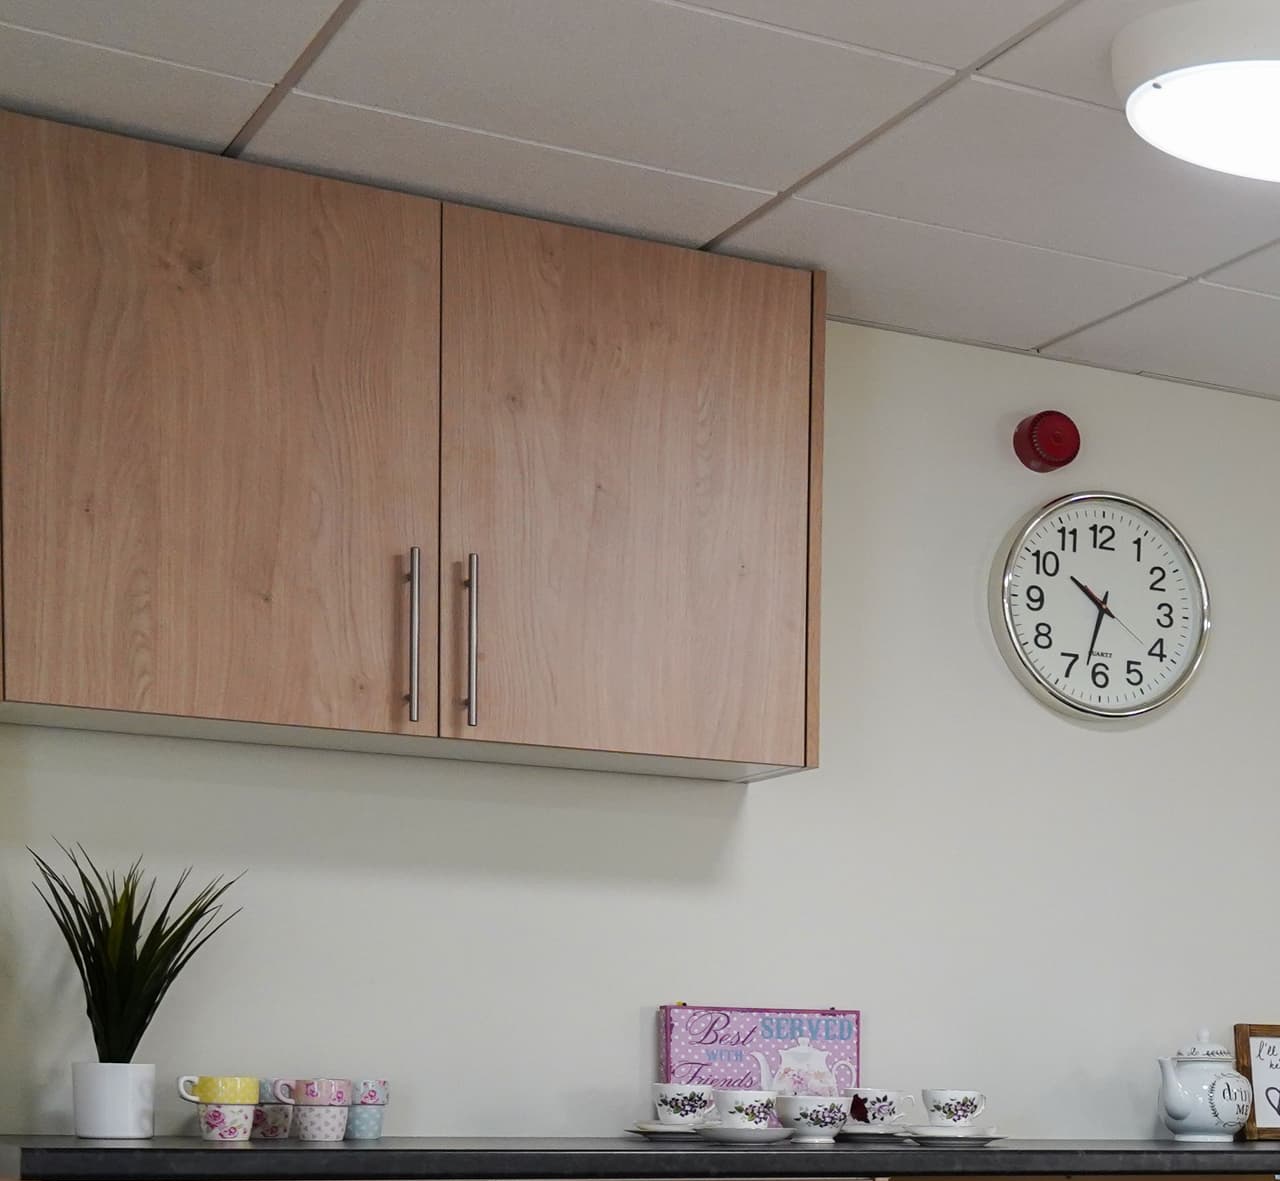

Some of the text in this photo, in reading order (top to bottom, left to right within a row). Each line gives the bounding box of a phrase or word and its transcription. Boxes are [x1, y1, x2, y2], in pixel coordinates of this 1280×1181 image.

[1057, 526, 1078, 552] 11
[1089, 524, 1115, 551] 12
[1132, 537, 1142, 562] 1
[1031, 550, 1060, 577] 10
[1149, 566, 1167, 592] 2
[1026, 585, 1045, 611] 9
[1156, 603, 1174, 628] 3
[1033, 622, 1053, 649] 8
[1147, 638, 1167, 662] 4
[1060, 652, 1080, 678] 7
[1091, 662, 1110, 688] 6
[1126, 660, 1144, 686] 5
[686, 1010, 853, 1047] Best SERVED
[704, 1049, 743, 1062] WITH
[1256, 1040, 1278, 1060] I'll
[672, 1061, 754, 1088] Friends
